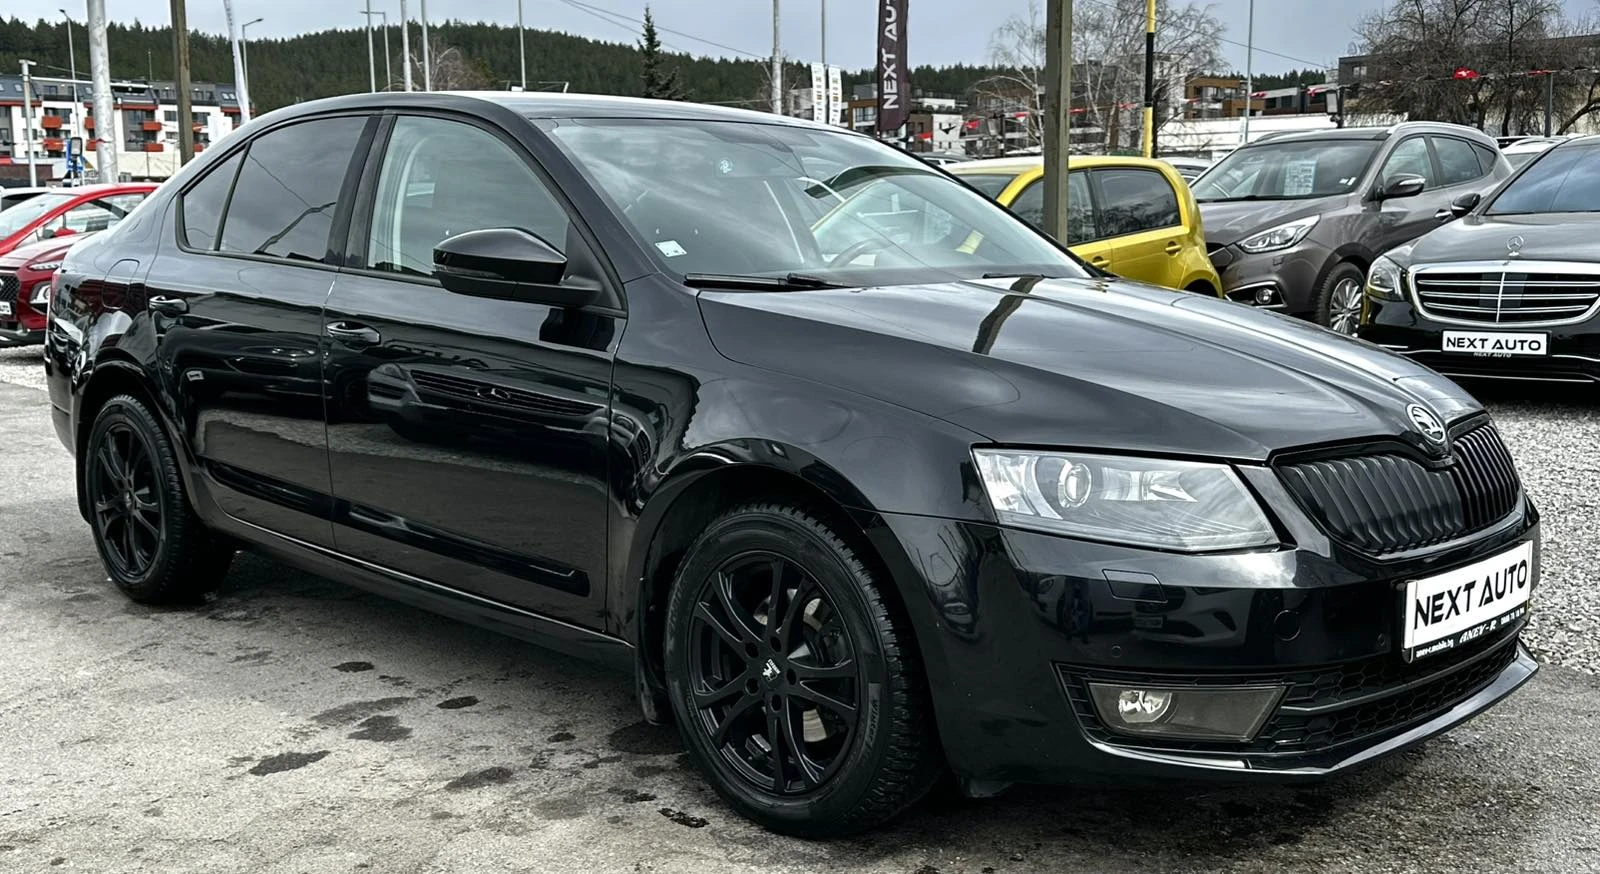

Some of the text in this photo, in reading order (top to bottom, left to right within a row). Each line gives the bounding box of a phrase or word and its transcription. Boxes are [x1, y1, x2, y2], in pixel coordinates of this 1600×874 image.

[882, 48, 899, 110] NEXT
[1446, 337, 1541, 351] NEXT AUTO
[1414, 559, 1527, 630] NEXT AUTO
